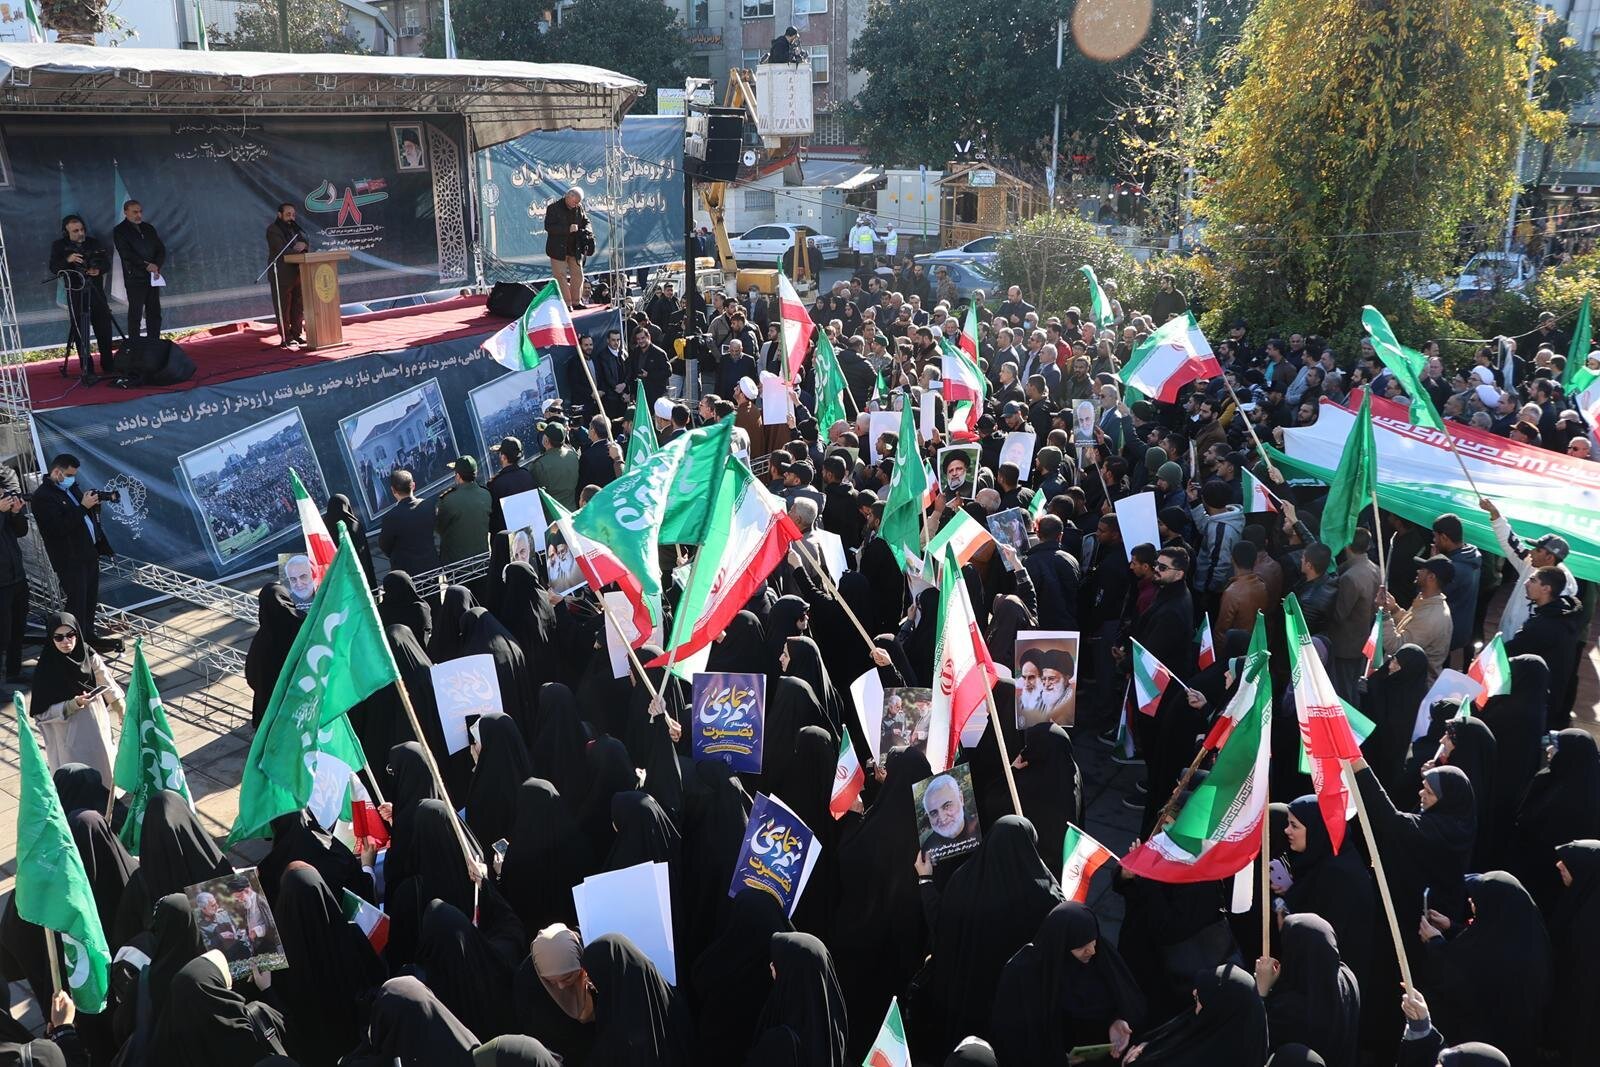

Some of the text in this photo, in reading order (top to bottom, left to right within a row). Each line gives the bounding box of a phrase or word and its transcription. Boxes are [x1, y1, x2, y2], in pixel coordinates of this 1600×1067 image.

[511, 161, 544, 187] ایران
[665, 159, 675, 182] از
[646, 194, 656, 211] به
[371, 364, 403, 383] احساس
[411, 361, 427, 376] عزم
[317, 378, 343, 395] حضور
[344, 375, 354, 388] به
[355, 369, 370, 387] نیاز
[262, 390, 273, 406] را
[274, 384, 293, 399] فتنه
[295, 382, 314, 398] علیه
[222, 398, 231, 415] از
[234, 393, 262, 412] زودتر
[151, 408, 178, 428] نشان
[181, 402, 219, 423] دیگران
[115, 414, 148, 432] دادند
[702, 727, 754, 740] بصیرت
[749, 855, 792, 895] بصیرت
